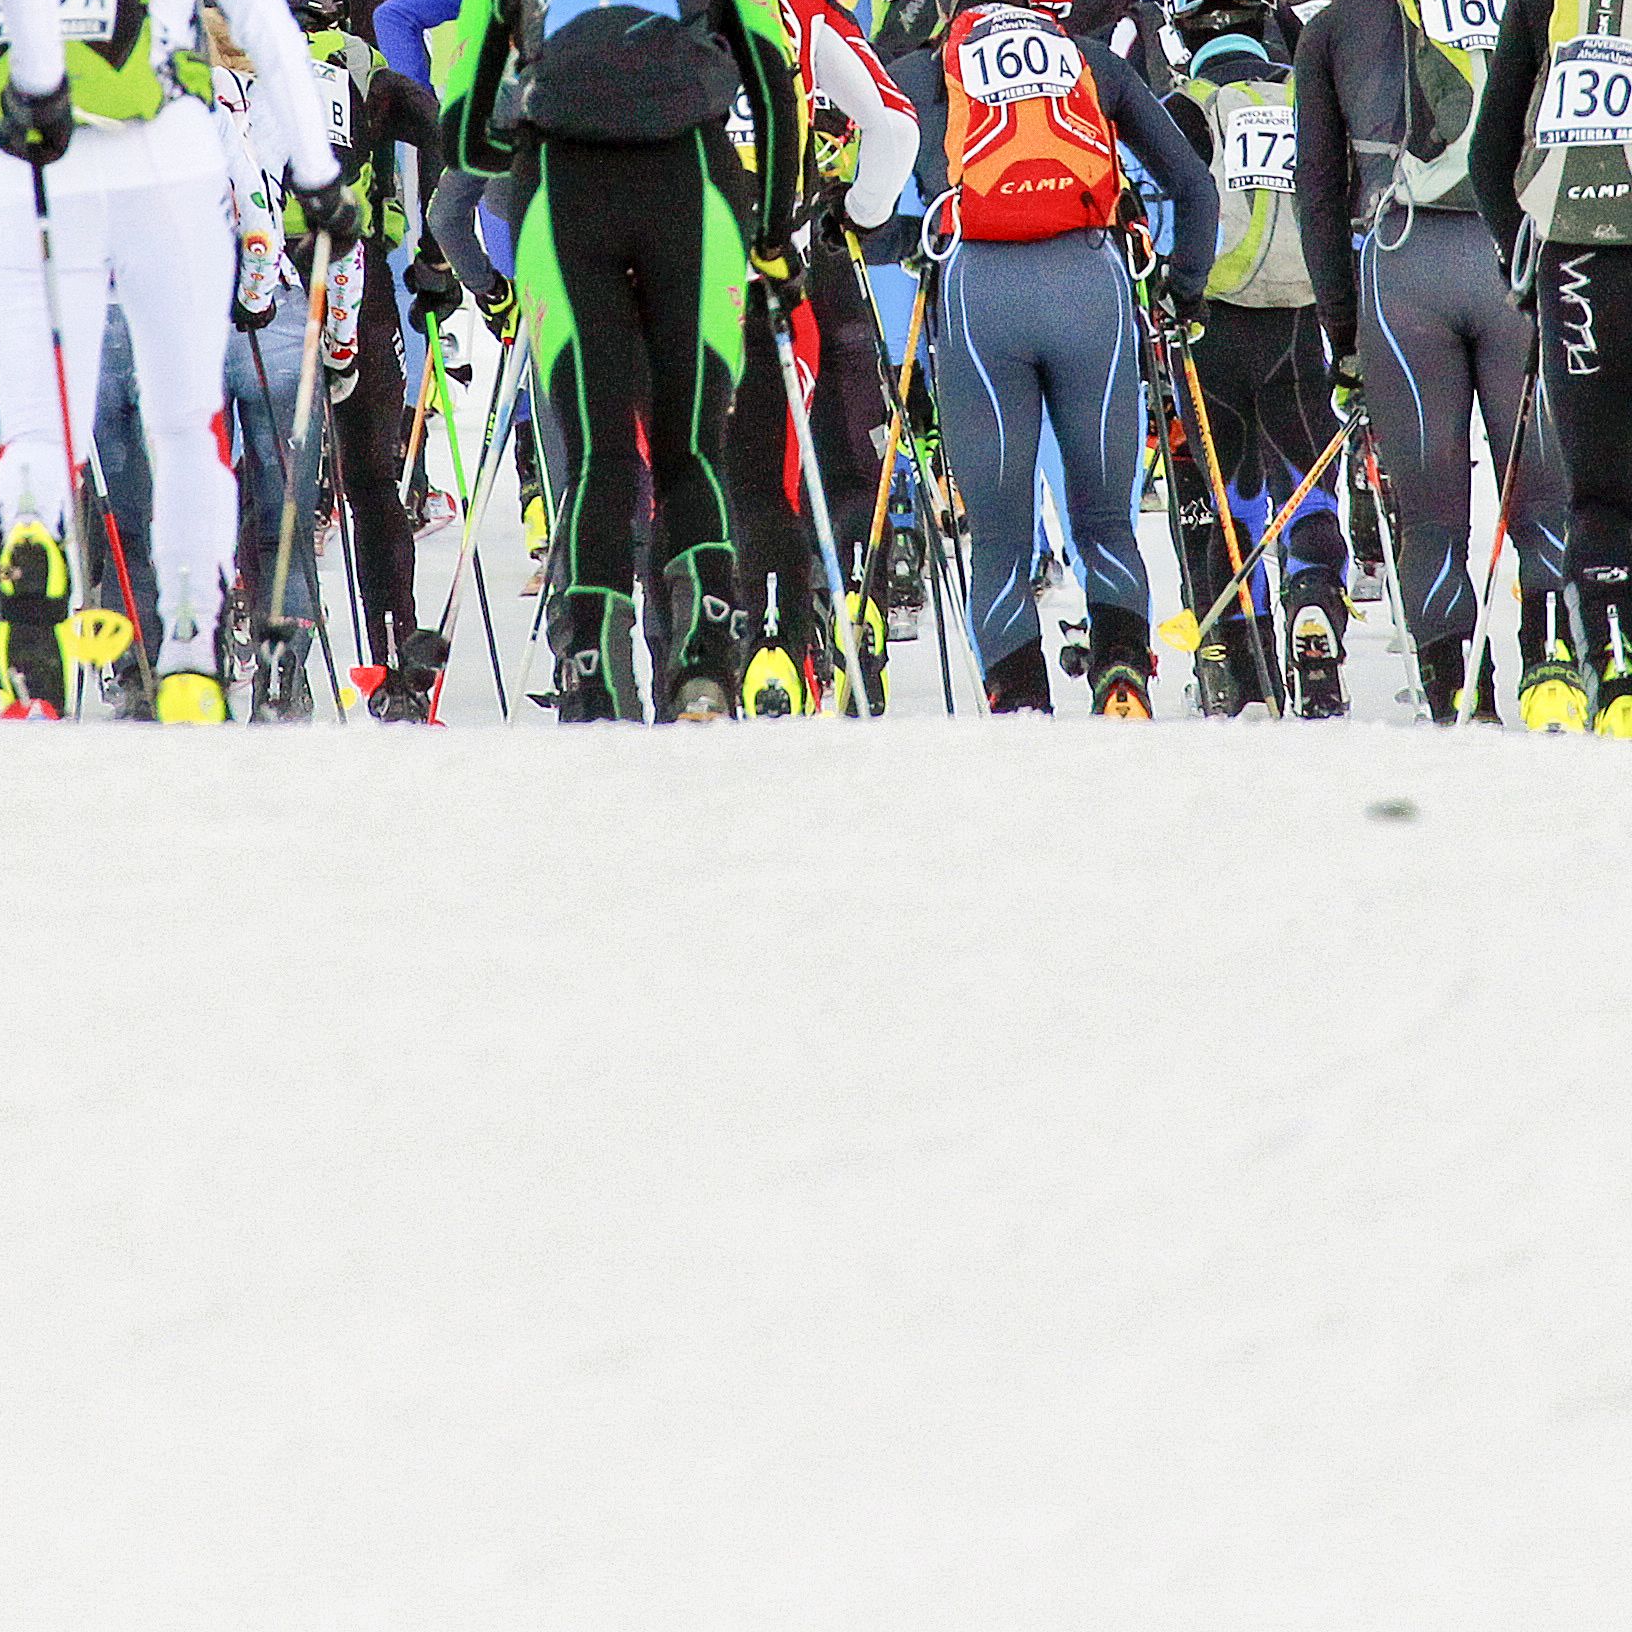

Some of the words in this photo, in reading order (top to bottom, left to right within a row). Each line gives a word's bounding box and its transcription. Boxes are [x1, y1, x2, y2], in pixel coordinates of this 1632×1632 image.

[971, 36, 1049, 85] 160
[1059, 54, 1075, 80] A
[1556, 68, 1632, 119] 130
[331, 100, 344, 127] B
[1235, 130, 1296, 171] 172
[1567, 128, 1614, 142] PIERRA
[999, 176, 1074, 195] CAMP
[1567, 183, 1631, 200] CAMP
[1558, 251, 1600, 376] PLUM
